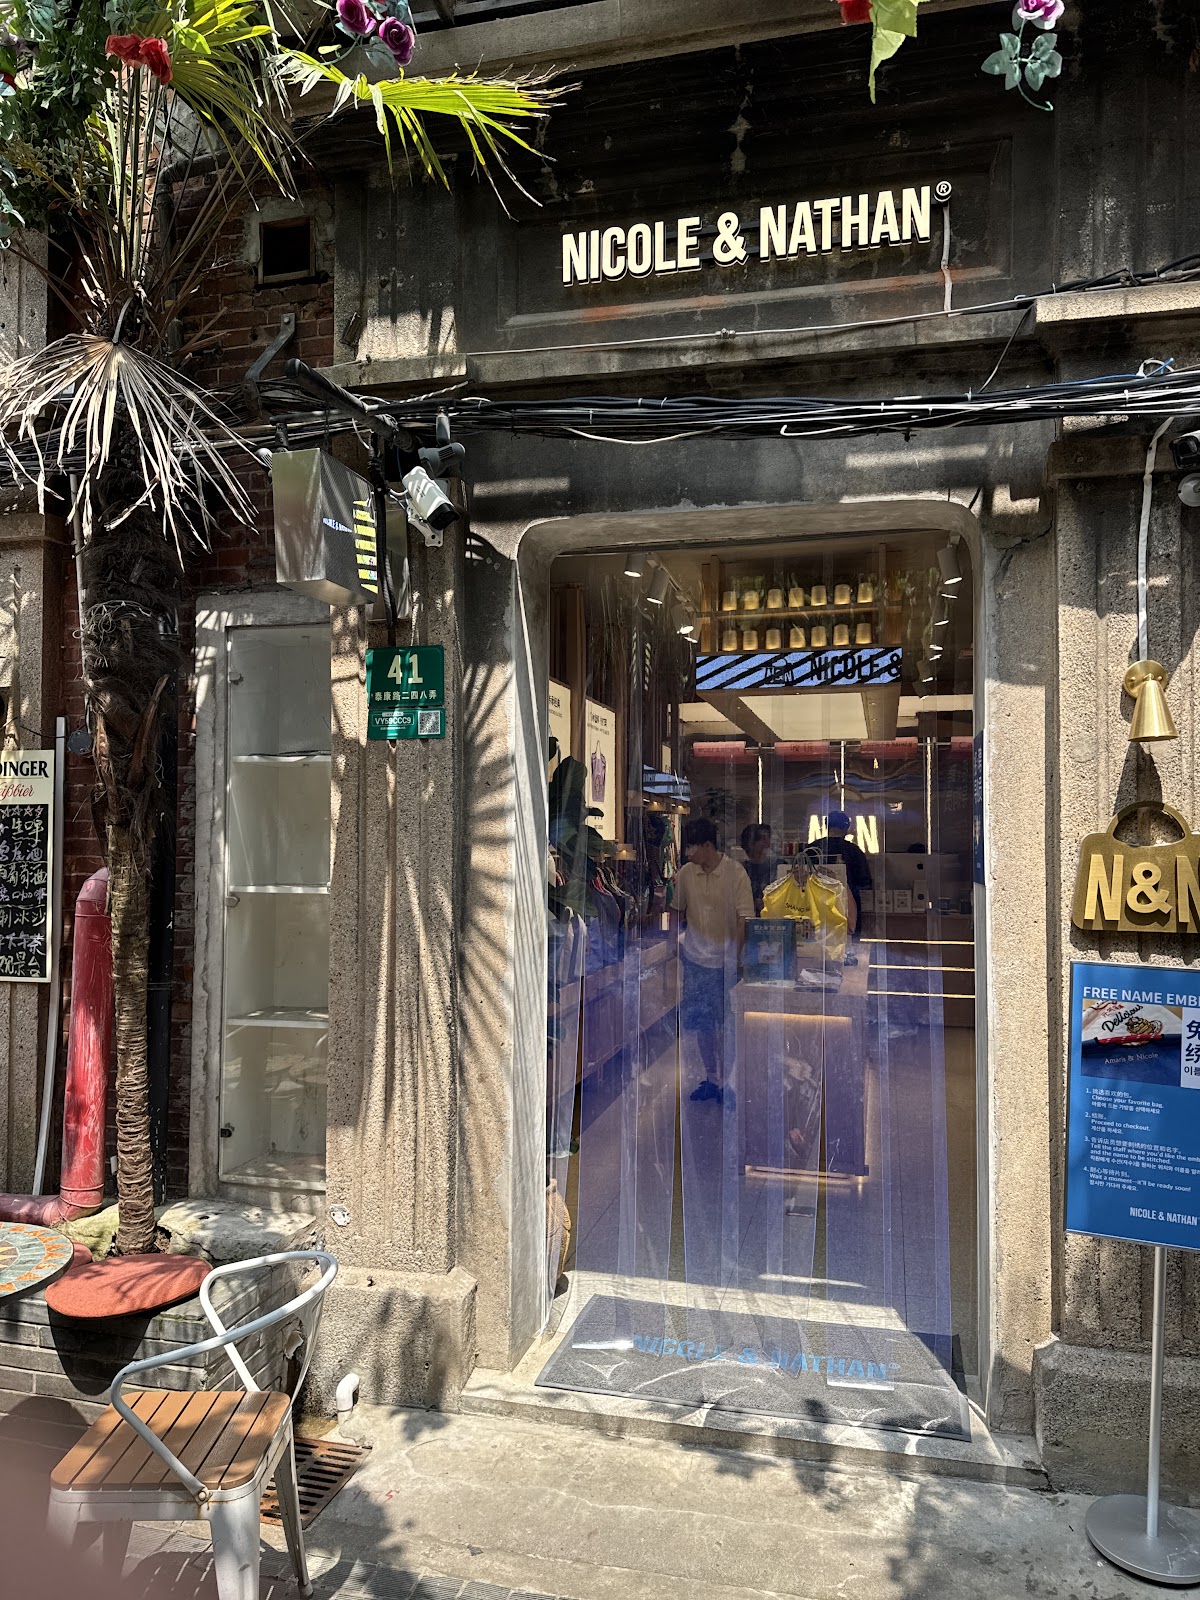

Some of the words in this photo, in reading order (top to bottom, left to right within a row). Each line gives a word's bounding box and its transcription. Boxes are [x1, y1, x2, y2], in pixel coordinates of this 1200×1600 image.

[562, 216, 702, 287] NICOLE
[712, 211, 749, 267] &
[387, 653, 423, 685] 41
[374, 689, 437, 701] 泰康路二四八弄
[0, 760, 49, 778] INGER
[1083, 986, 1118, 1000] FREE
[1122, 989, 1162, 1004] NAME
[1101, 1004, 1144, 1033] Delicious
[1136, 1052, 1158, 1060] Nicole
[1091, 1119, 1114, 1127] Proceed
[1123, 1122, 1151, 1132] checkout.
[1146, 1156, 1172, 1164] stitched.
[1156, 1183, 1174, 1191] ready
[1130, 1206, 1156, 1220] NICOLE
[1158, 1212, 1165, 1220] &
[737, 1346, 760, 1364] &
